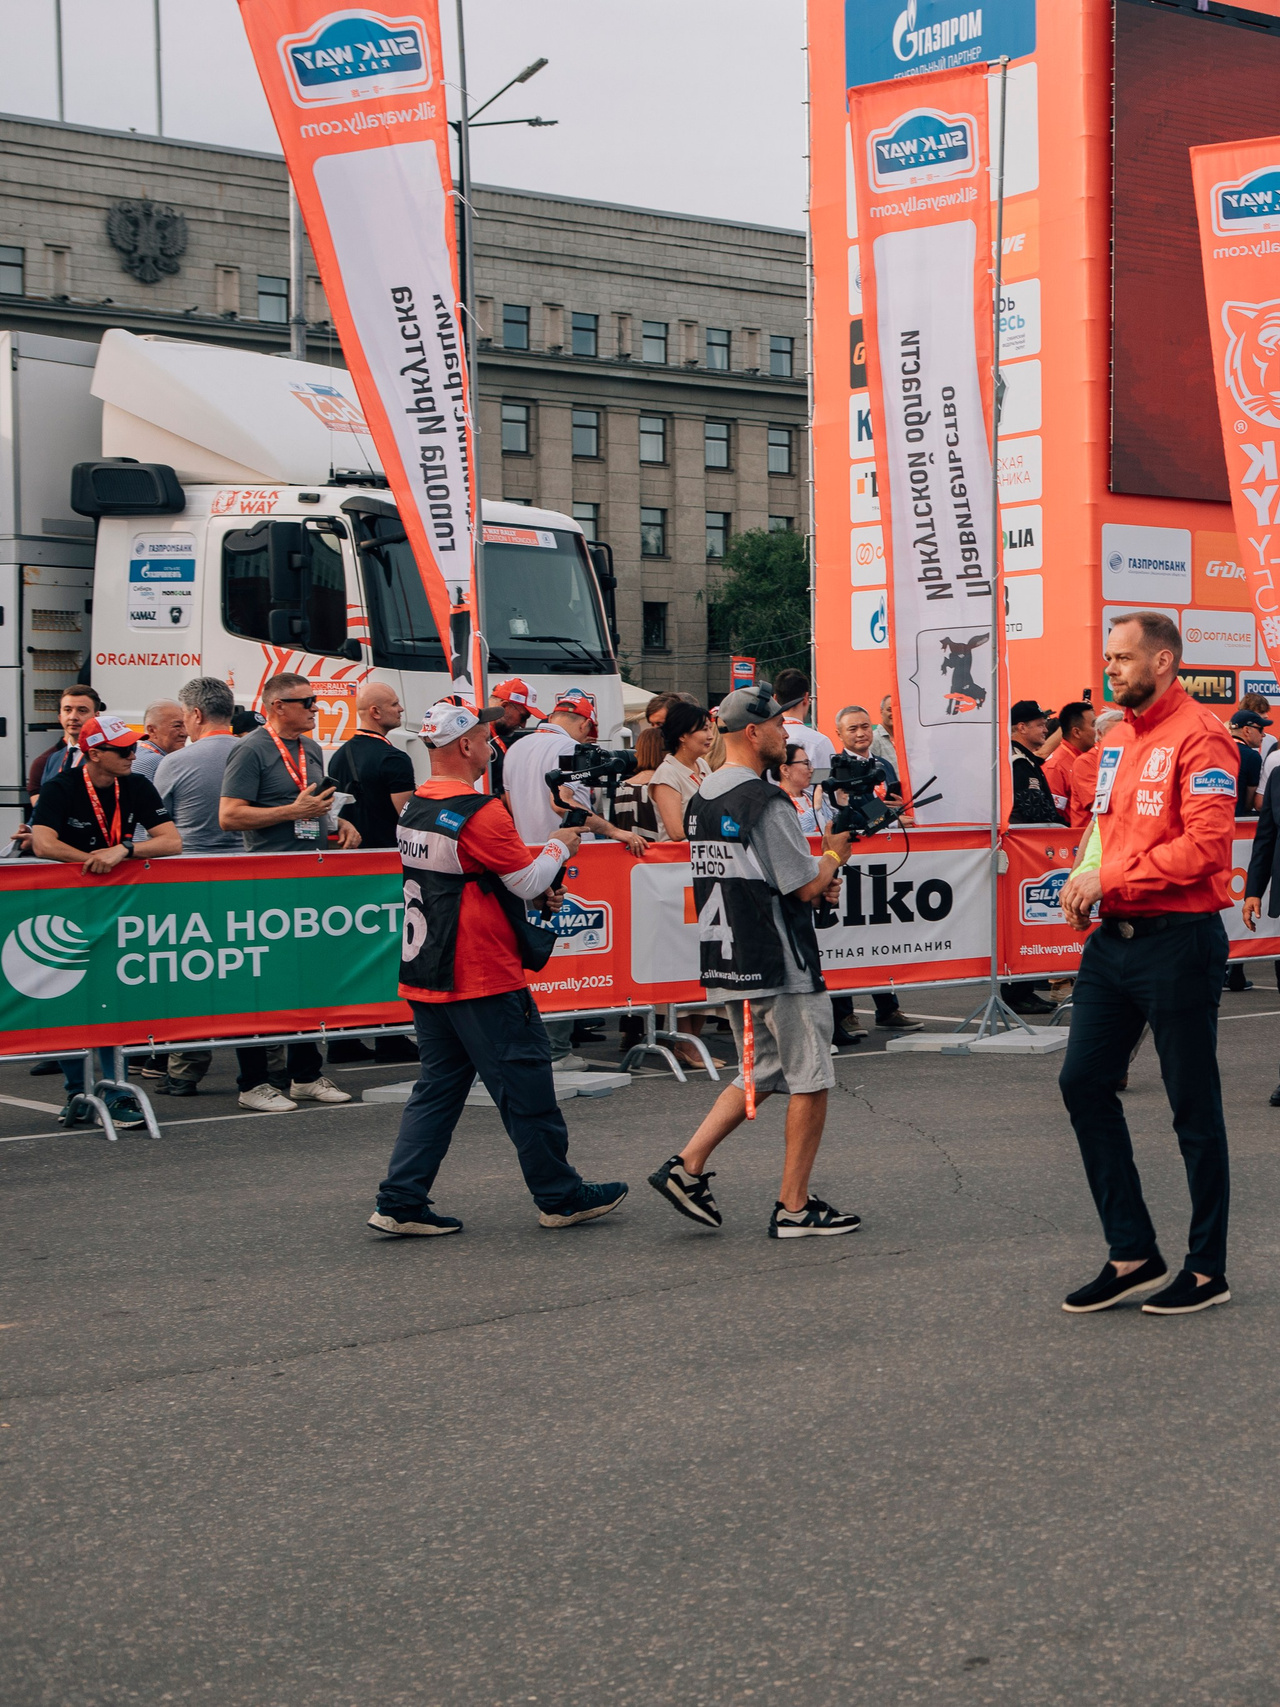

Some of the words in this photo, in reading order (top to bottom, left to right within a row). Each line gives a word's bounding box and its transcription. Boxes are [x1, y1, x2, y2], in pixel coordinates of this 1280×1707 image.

[917, 9, 983, 57] ГАЗПРОМ
[240, 501, 278, 514] WAY
[1128, 557, 1187, 572] ГАЗПРОМБАНК
[130, 611, 157, 621] KAMAZ
[1203, 631, 1252, 643] СОГЛАСИЕ
[96, 652, 201, 667] ORGANIZATION
[570, 771, 592, 782] RONIN
[1195, 777, 1216, 785] SILK
[1136, 789, 1164, 804] SILK
[1136, 802, 1164, 817] WAY
[691, 844, 733, 860] FFICIAL
[117, 912, 213, 948] РИА
[227, 903, 405, 942] НОВОСТ
[558, 912, 600, 928] WAY
[700, 882, 734, 961] 4
[871, 940, 952, 957] КОМПАНИЯ
[116, 946, 270, 985] СПОРТ
